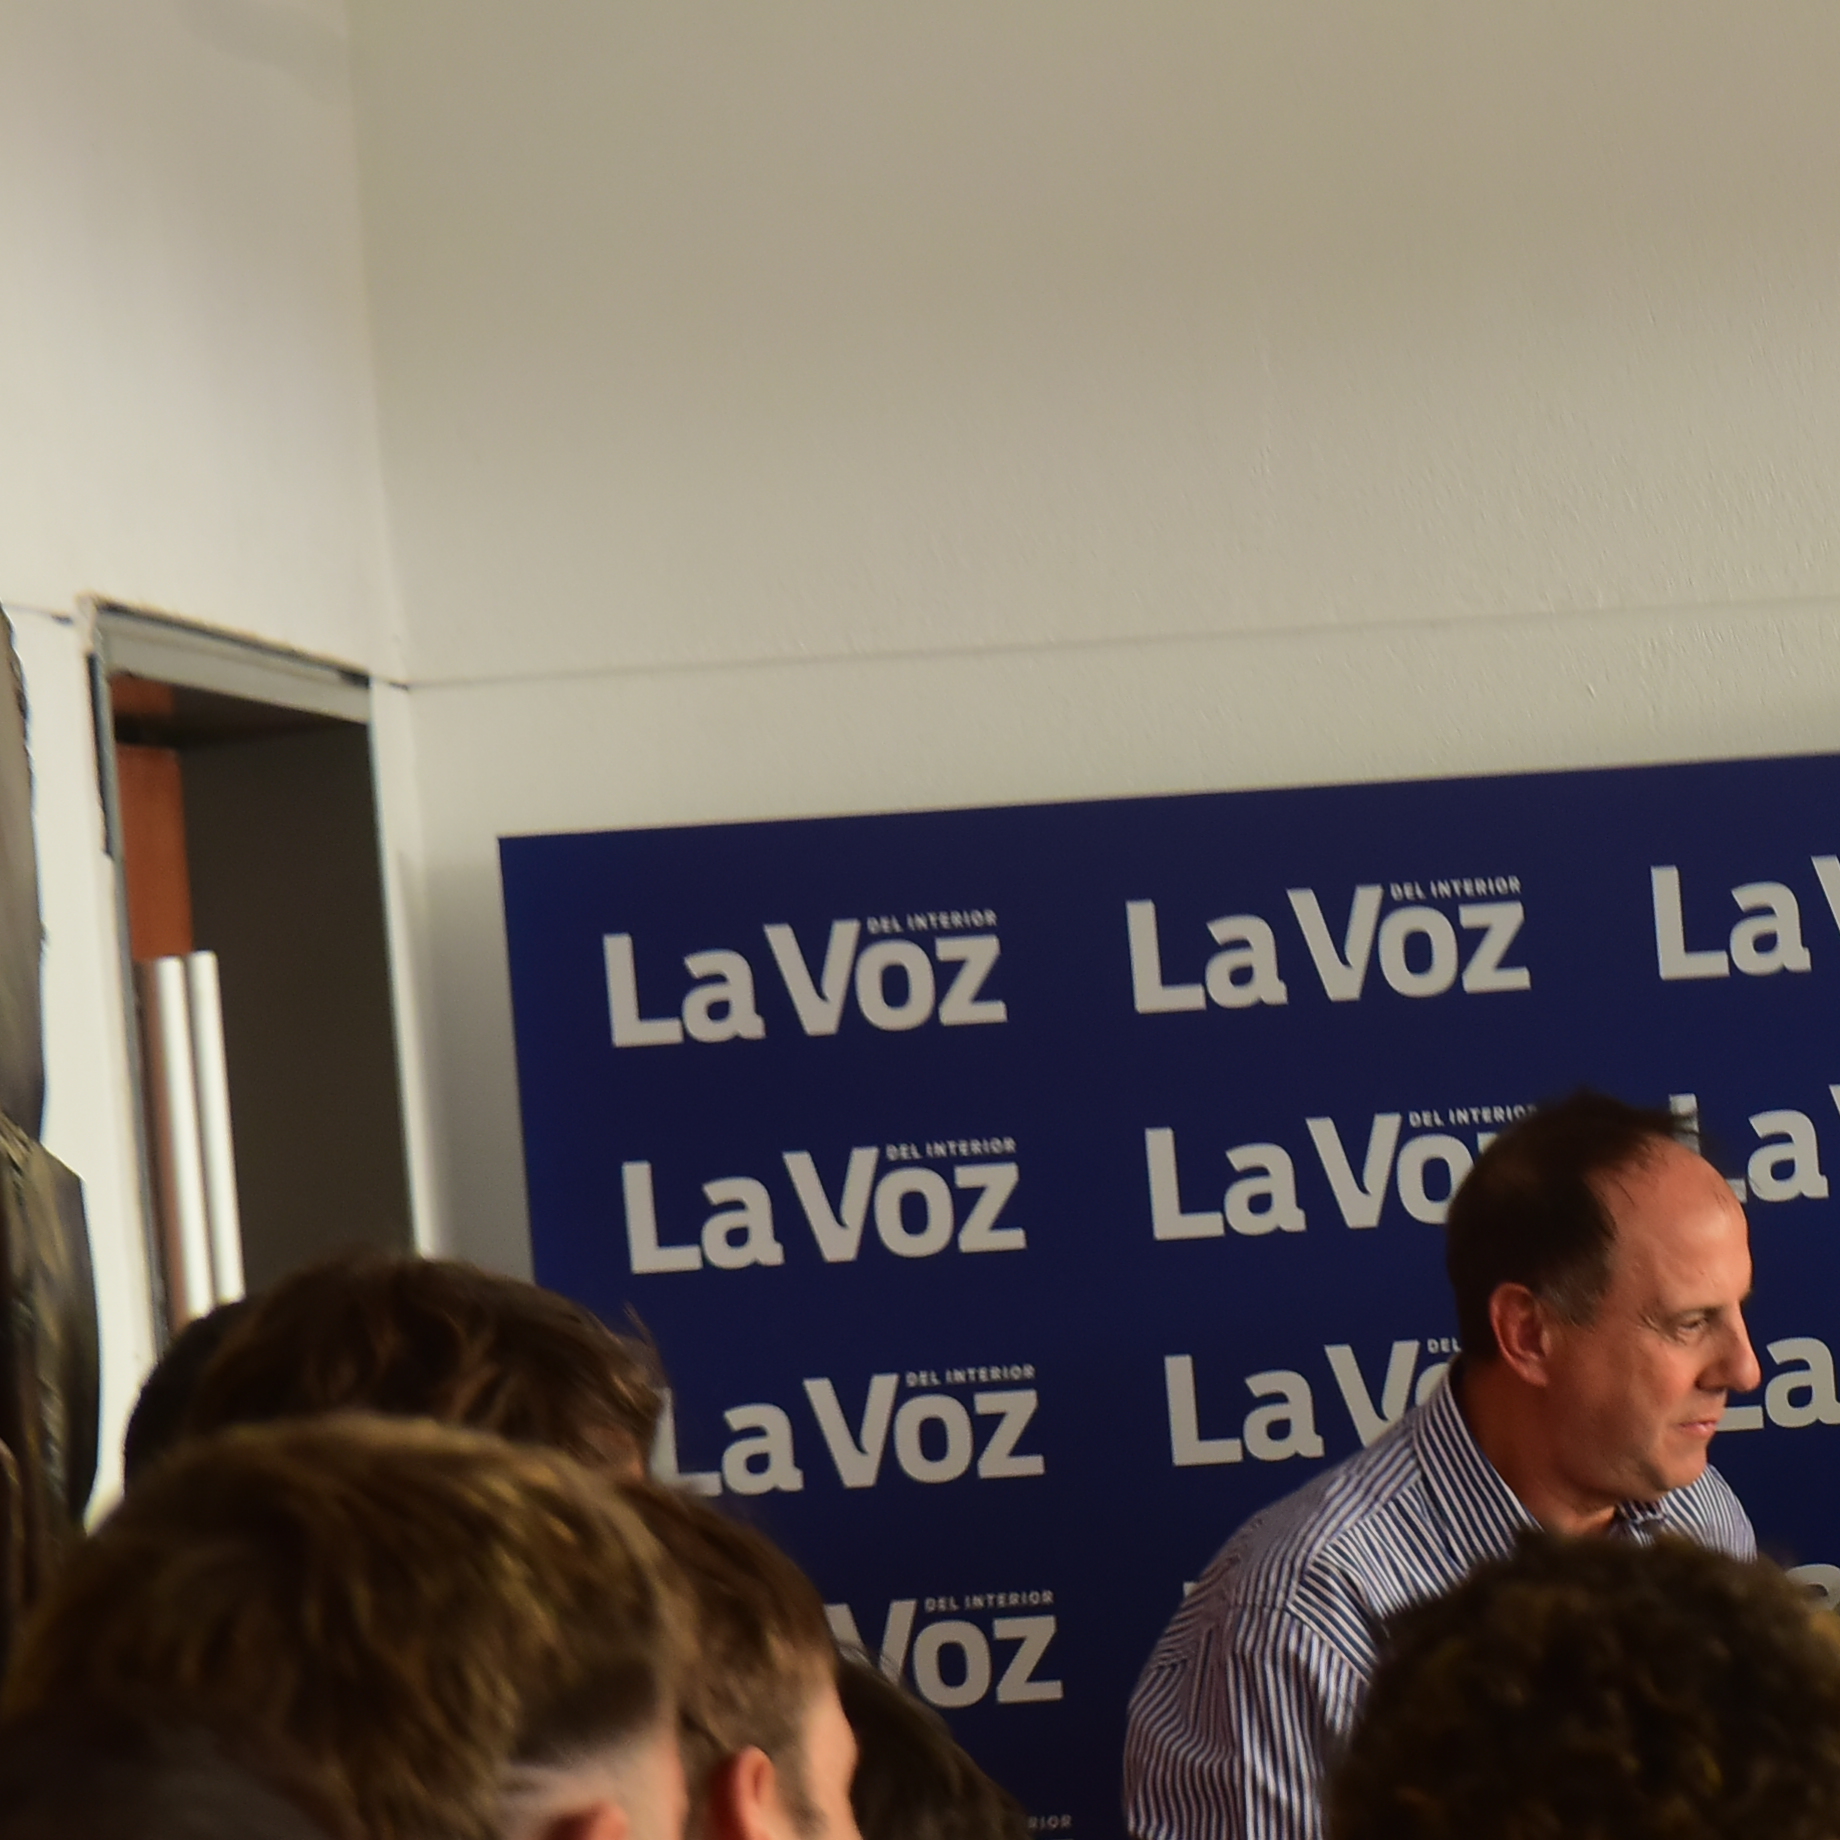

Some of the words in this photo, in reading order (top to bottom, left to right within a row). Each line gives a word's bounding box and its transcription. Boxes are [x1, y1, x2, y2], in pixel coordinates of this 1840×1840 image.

[1390, 881, 1426, 900] DEL
[1428, 873, 1520, 898] INTERIOR
[866, 916, 902, 935] DEL
[904, 908, 996, 933] INTERIOR
[1408, 1109, 1444, 1128] DEL
[885, 1143, 921, 1162] DEL
[923, 1135, 1015, 1160] INTERIOR
[904, 1370, 940, 1389] DEL
[942, 1362, 1034, 1387] INTERIOR
